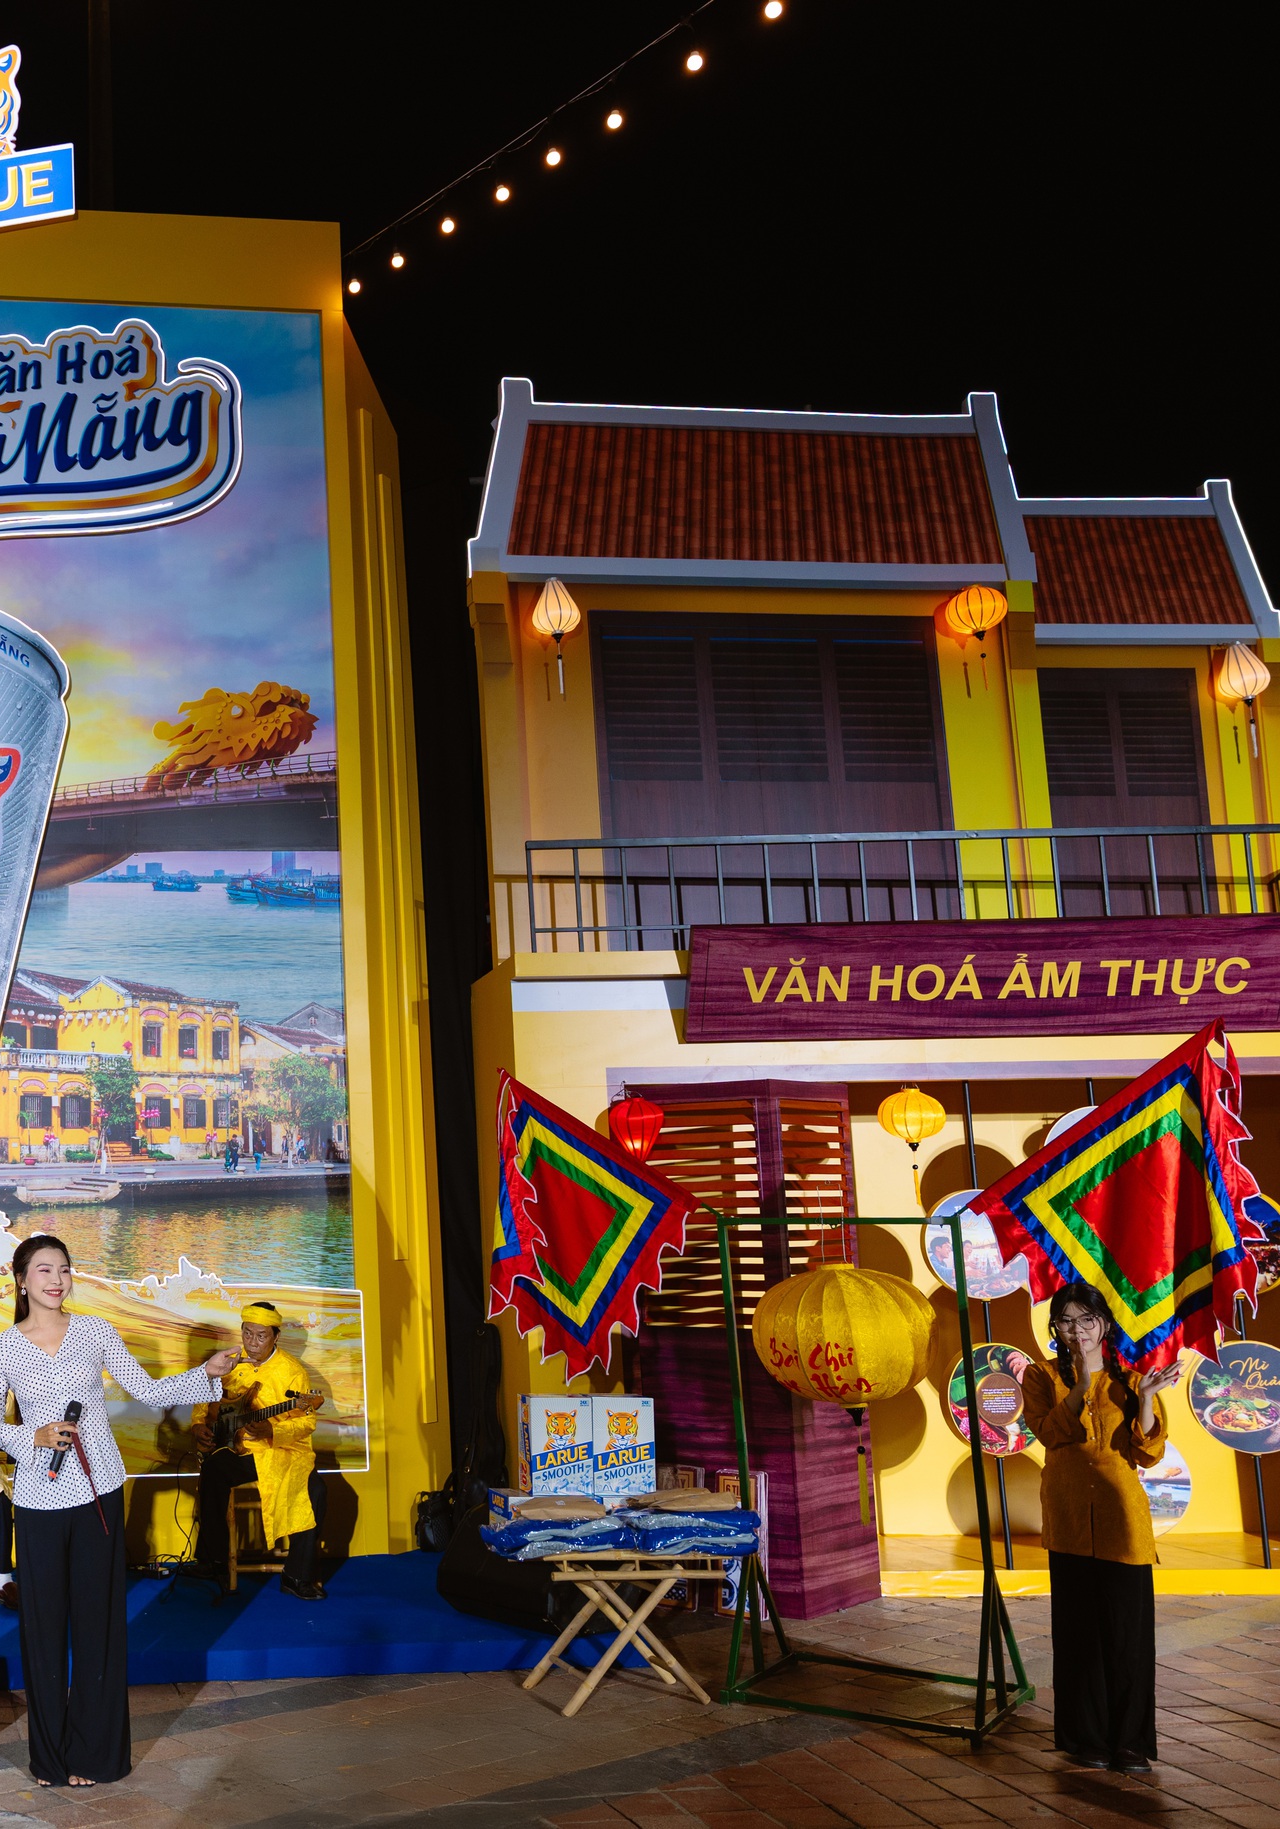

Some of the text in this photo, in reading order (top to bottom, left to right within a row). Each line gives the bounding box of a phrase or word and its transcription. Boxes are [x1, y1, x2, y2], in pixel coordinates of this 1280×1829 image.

[56, 334, 140, 386] Hoá
[742, 953, 1252, 1004] VĂN HOÁ ẨM THỰC
[1229, 1356, 1270, 1376] Mì
[1242, 1371, 1280, 1391] Quả
[535, 1444, 589, 1471] LARUE
[597, 1444, 651, 1470] LARUE
[542, 1463, 585, 1482] SMOOTH
[604, 1463, 647, 1481] SMOOTH
